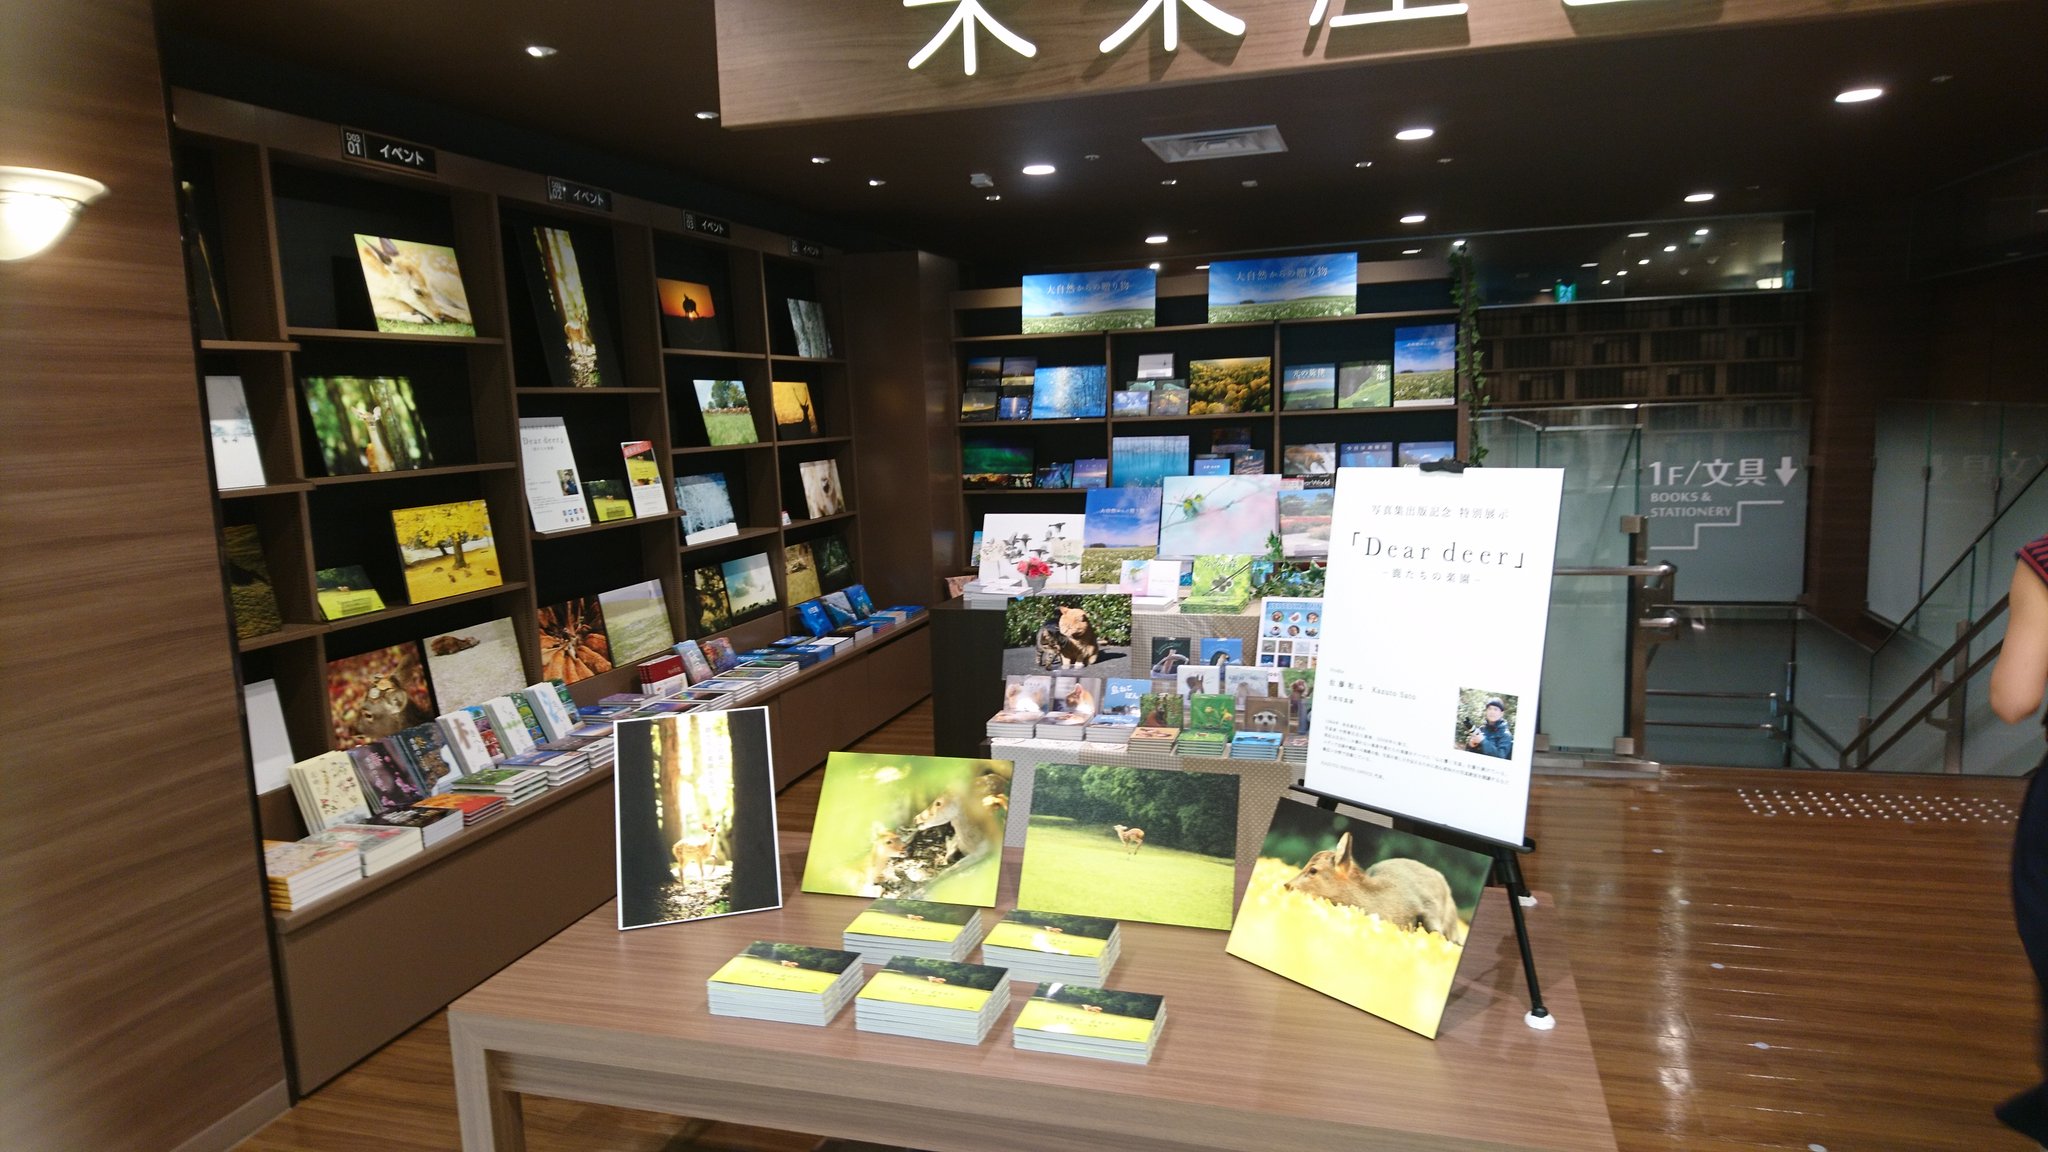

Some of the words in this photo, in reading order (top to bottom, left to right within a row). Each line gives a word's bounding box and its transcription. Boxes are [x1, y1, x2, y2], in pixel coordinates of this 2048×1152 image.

[347, 141, 361, 156] 01
[380, 144, 424, 165] イベント
[573, 189, 604, 206] イベント
[701, 220, 724, 234] イベント
[1236, 265, 1328, 281] 大自然からの贈り物
[1047, 279, 1130, 295] 大自然からの贈り物
[1649, 457, 1767, 487] 1F/文具
[1650, 491, 1698, 503] BOOKS
[1701, 491, 1712, 502] &
[1371, 504, 1452, 518] 写真集出版記念
[1459, 507, 1509, 519] 特別展示
[1650, 506, 1733, 518] STATIONERY
[1351, 531, 1430, 560] 「Dear
[1442, 541, 1524, 569] deer」
